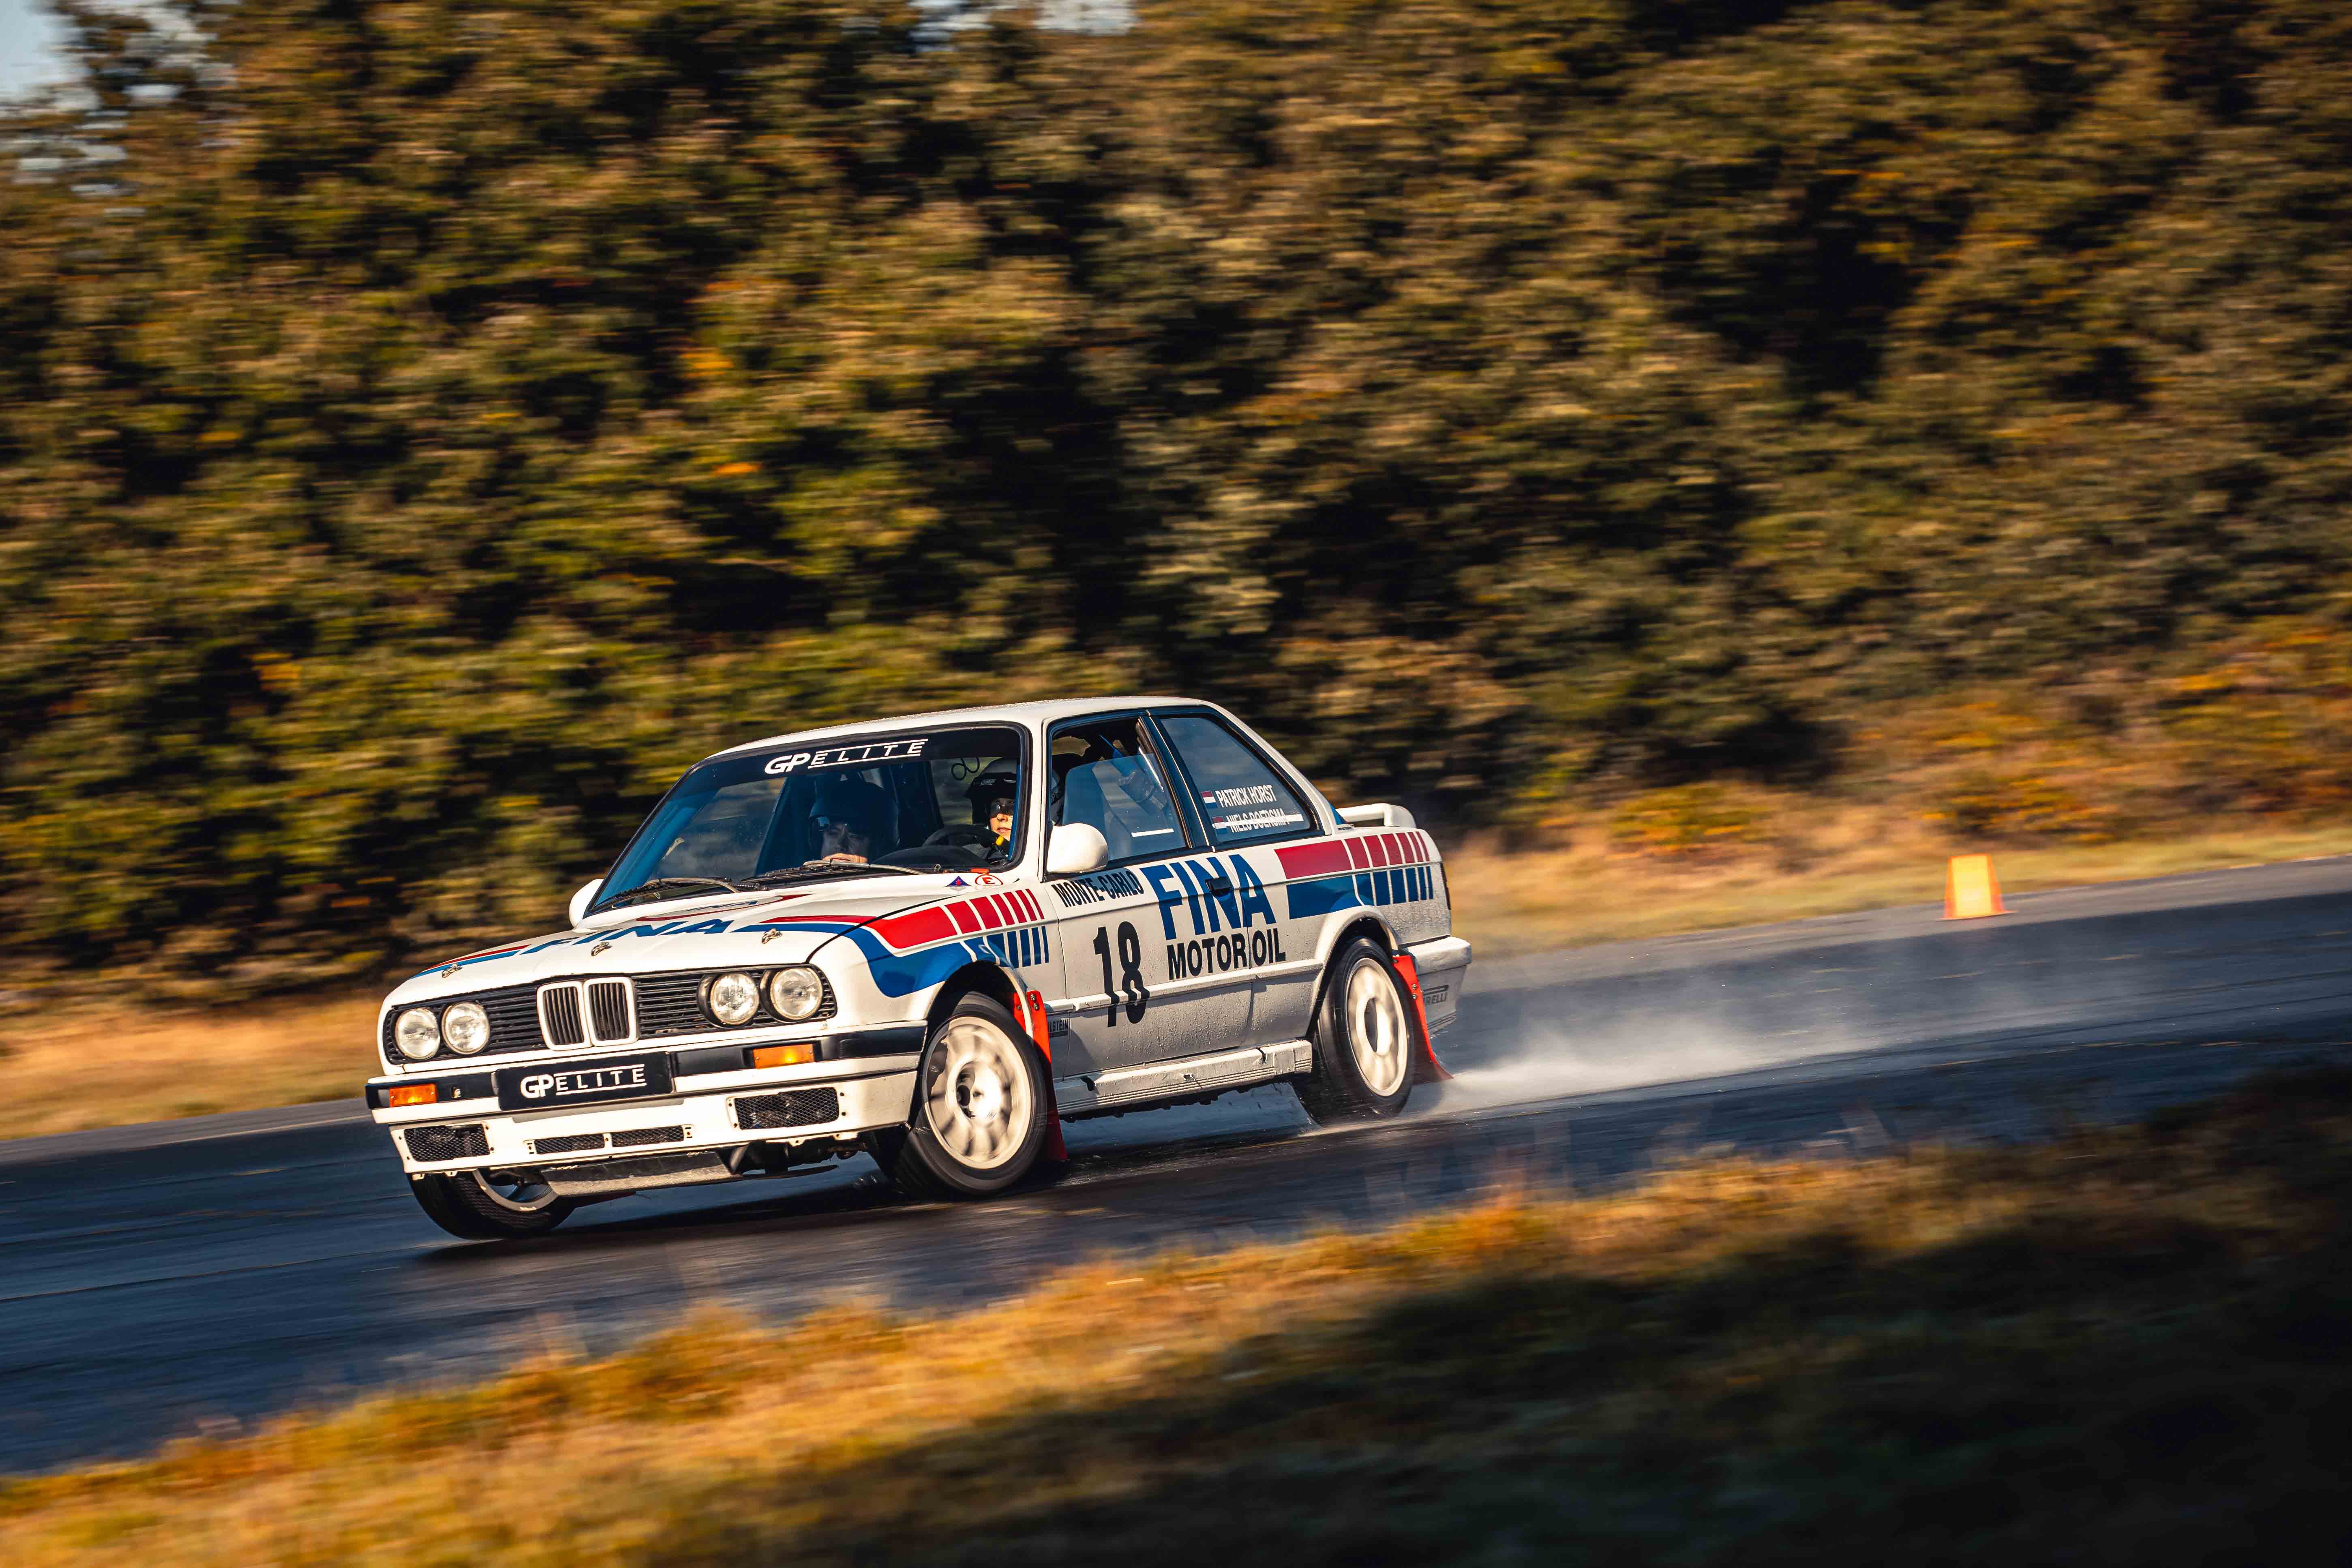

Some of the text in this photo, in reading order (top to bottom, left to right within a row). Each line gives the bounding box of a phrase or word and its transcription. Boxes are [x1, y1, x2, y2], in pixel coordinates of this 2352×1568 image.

[765, 741, 925, 774] GP ELITE
[1215, 784, 1277, 808] PATRICK HORST
[1051, 871, 1144, 908] MONTE-CARLO
[1139, 854, 1277, 940] FINA
[519, 919, 735, 955] FINA
[1167, 928, 1286, 980] MOTOR OIL
[1093, 921, 1150, 1027] 18
[1047, 1018, 1069, 1032] ILSTEIN
[519, 1068, 645, 1098] GP ELITE
